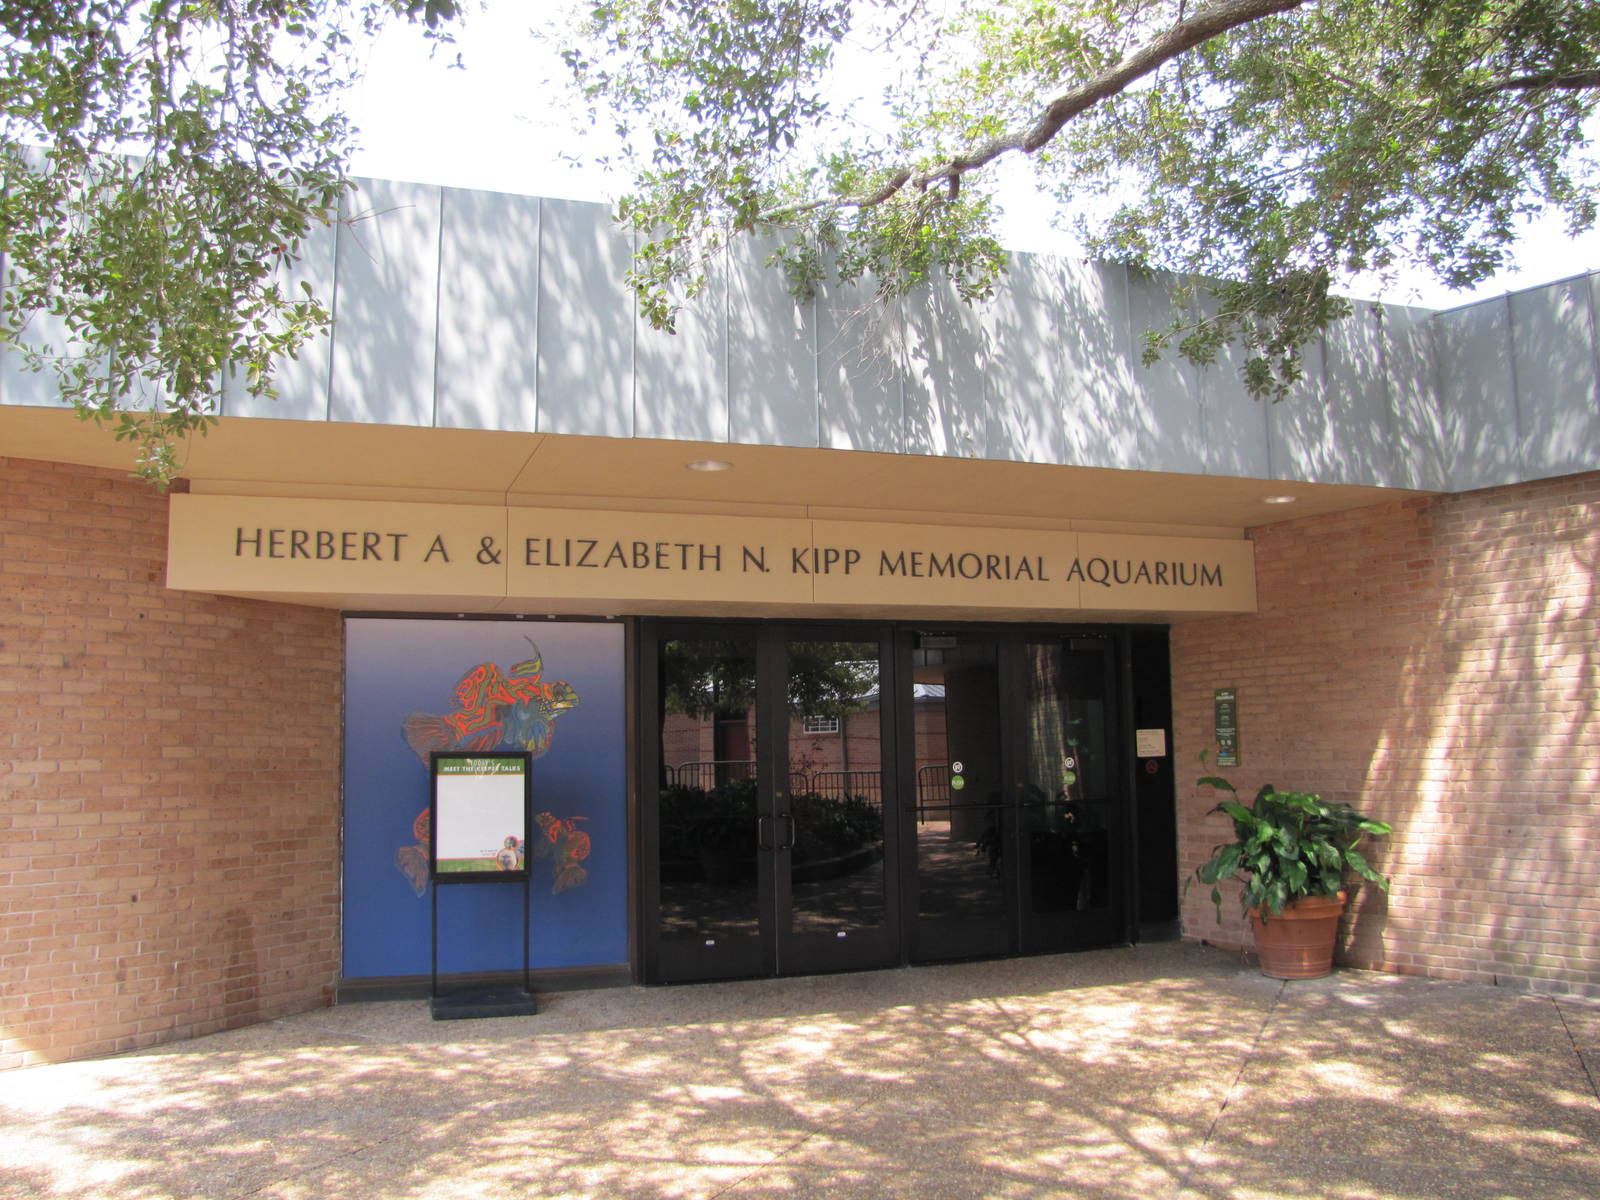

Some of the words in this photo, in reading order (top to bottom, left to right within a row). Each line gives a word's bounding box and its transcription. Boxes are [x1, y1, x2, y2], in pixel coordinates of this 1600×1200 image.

[234, 527, 408, 563] HERBERT
[423, 535, 450, 563] A
[476, 536, 501, 565] &
[525, 538, 720, 572] ELIZABETH
[742, 545, 771, 574] N.
[792, 547, 861, 577] KIPP
[879, 552, 1050, 583] MEMORIAL
[1066, 557, 1223, 588] AQUARIUM
